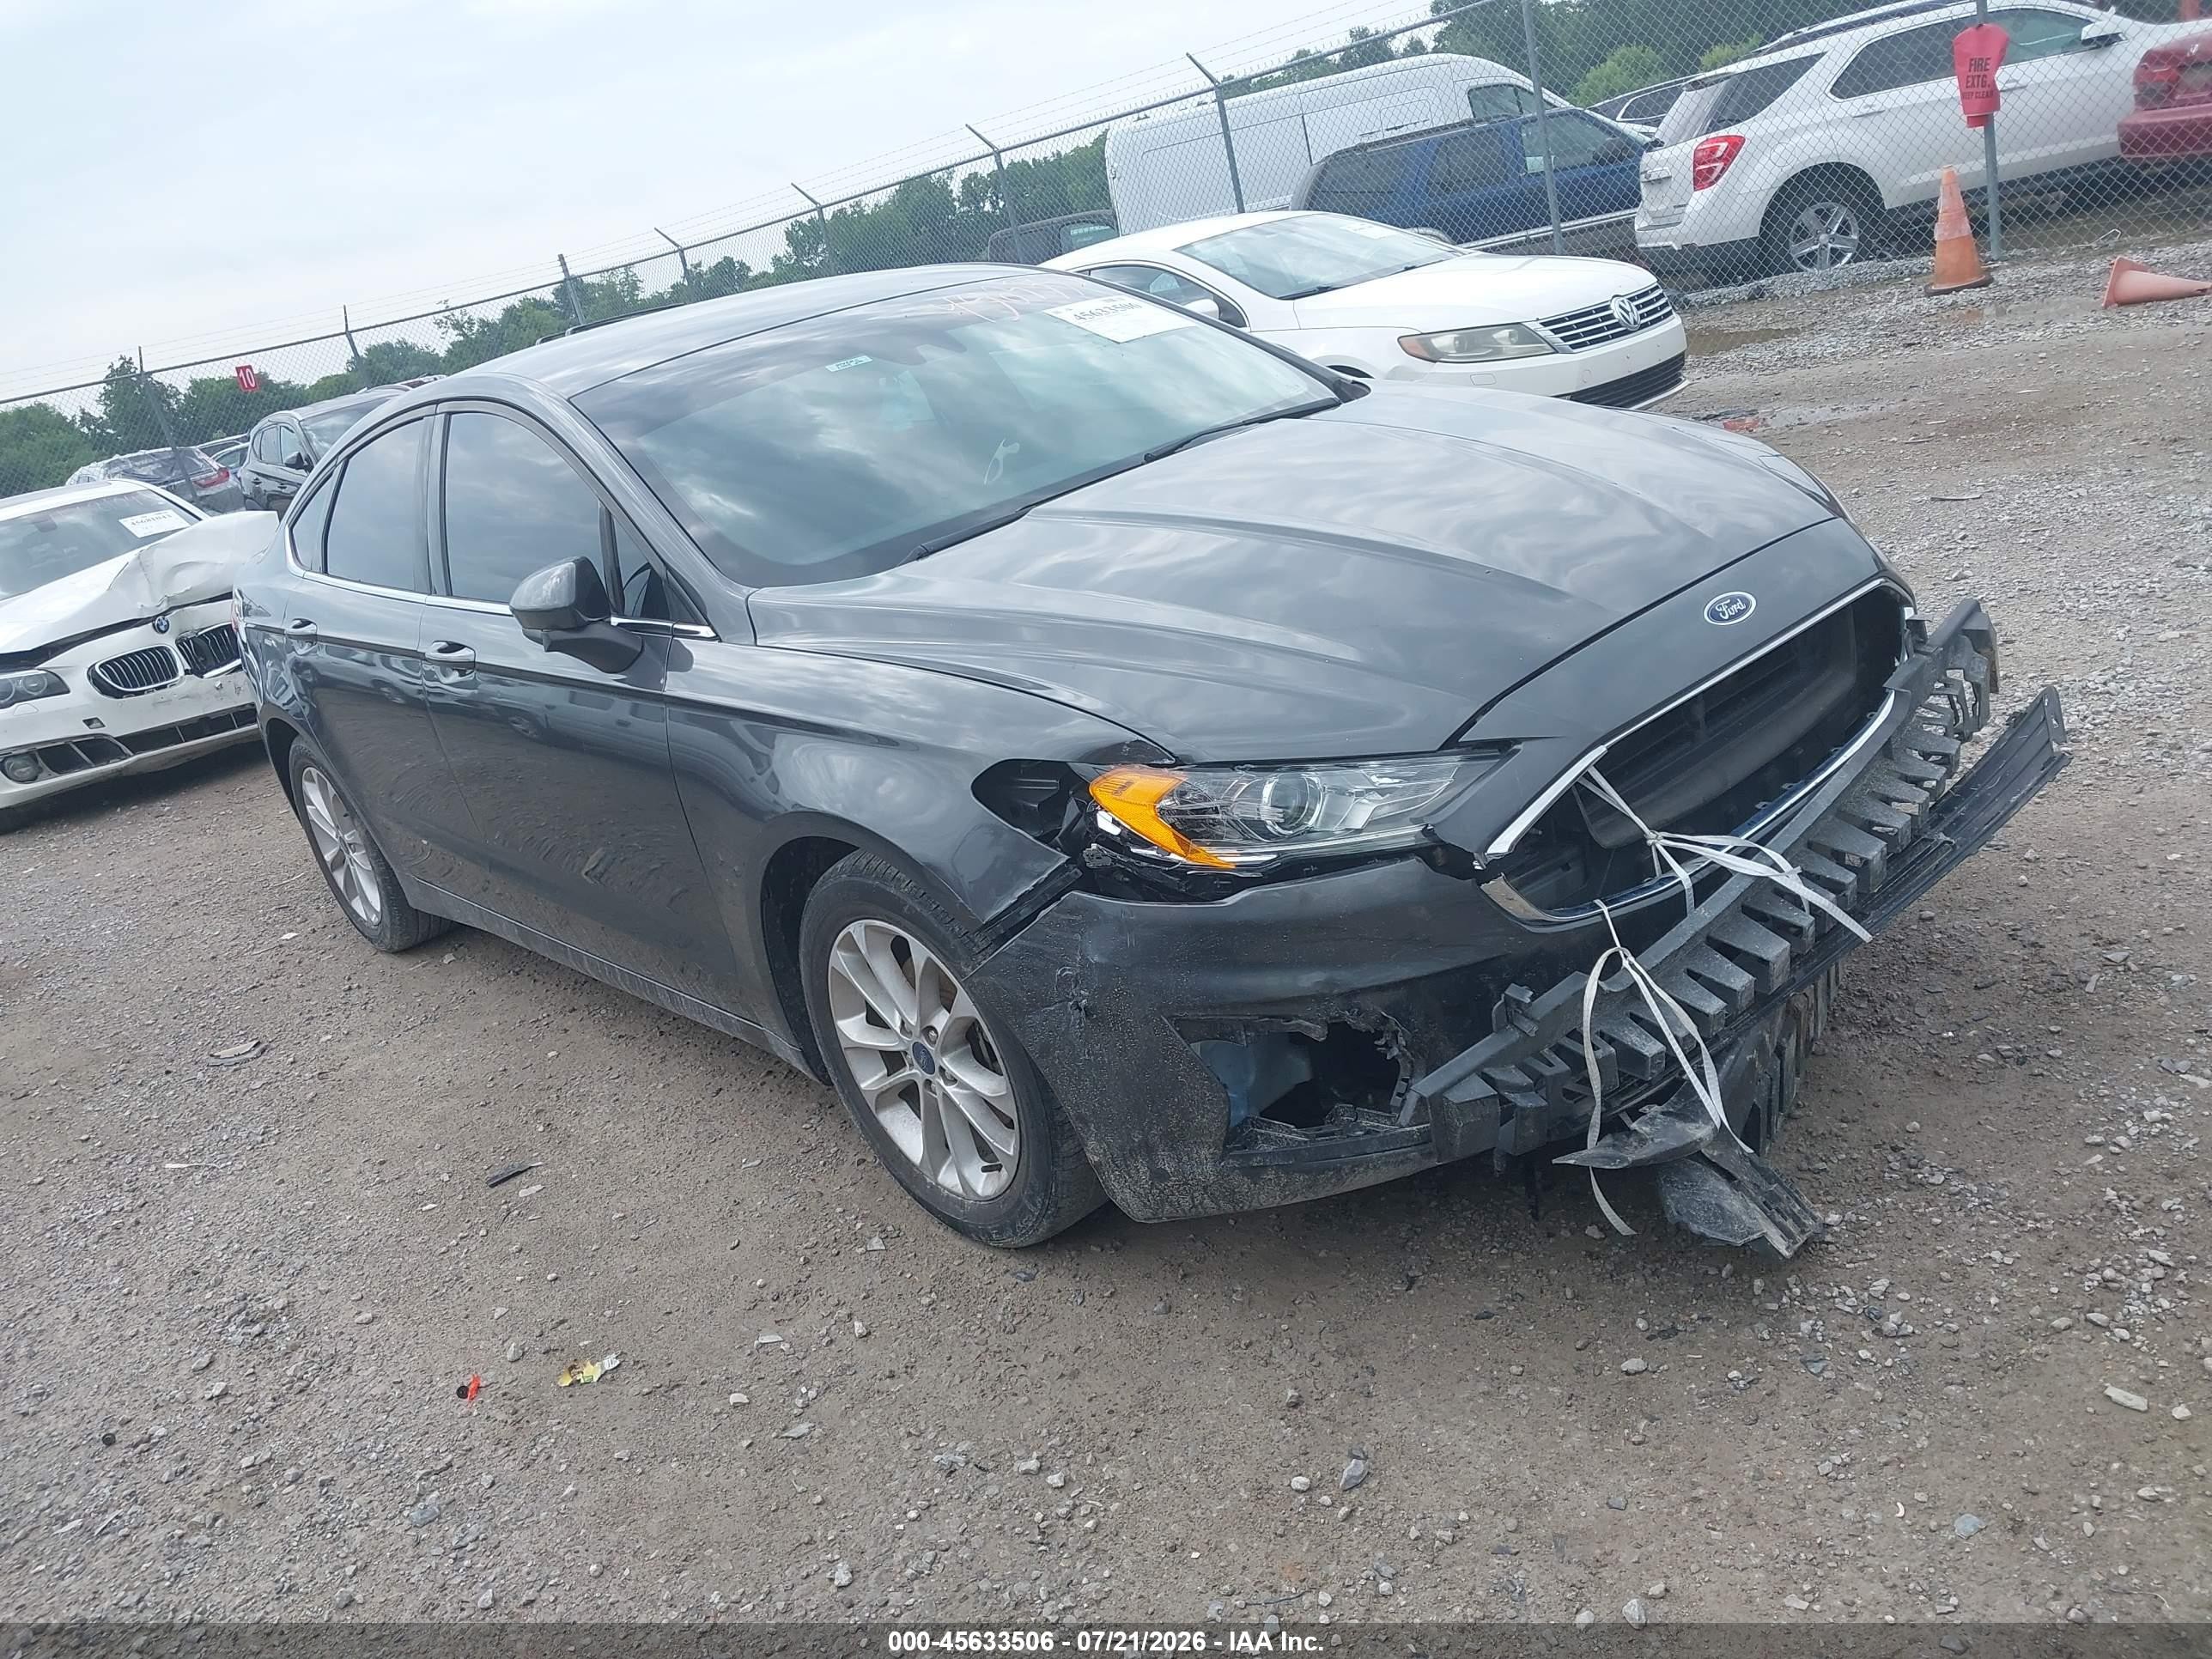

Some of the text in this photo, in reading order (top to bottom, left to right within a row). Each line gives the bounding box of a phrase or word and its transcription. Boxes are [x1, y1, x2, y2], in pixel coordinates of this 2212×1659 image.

[1969, 58, 1991, 72] FIRE
[1966, 75, 1990, 88] EXTG.
[239, 368, 256, 388] 10
[1716, 599, 1746, 619] Ford
